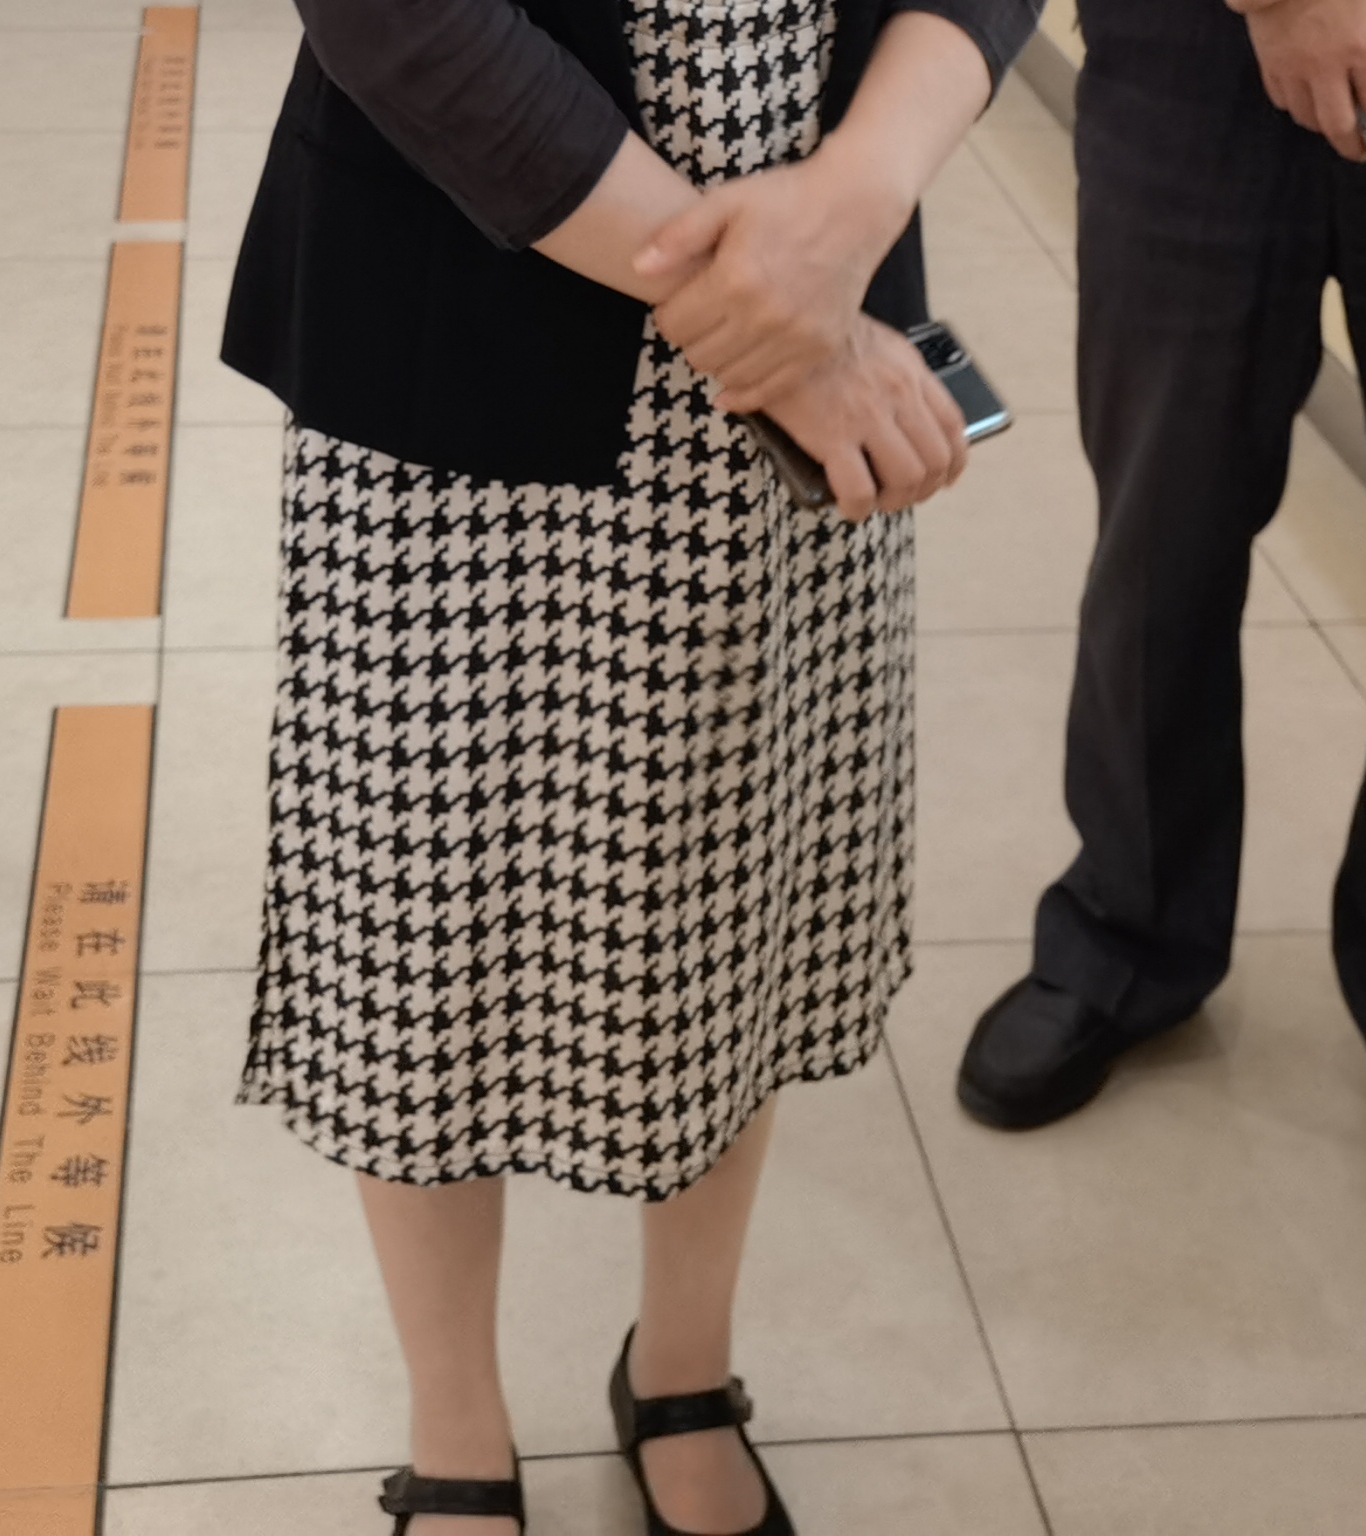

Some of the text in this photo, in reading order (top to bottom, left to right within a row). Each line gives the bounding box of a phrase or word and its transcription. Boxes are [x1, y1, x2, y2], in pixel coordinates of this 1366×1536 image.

[39, 882, 73, 952] Please
[28, 967, 63, 1018] Wait
[17, 1032, 56, 1117] Behind
[40, 880, 132, 1261] 请在此线外等候
[8, 1134, 46, 1185] The
